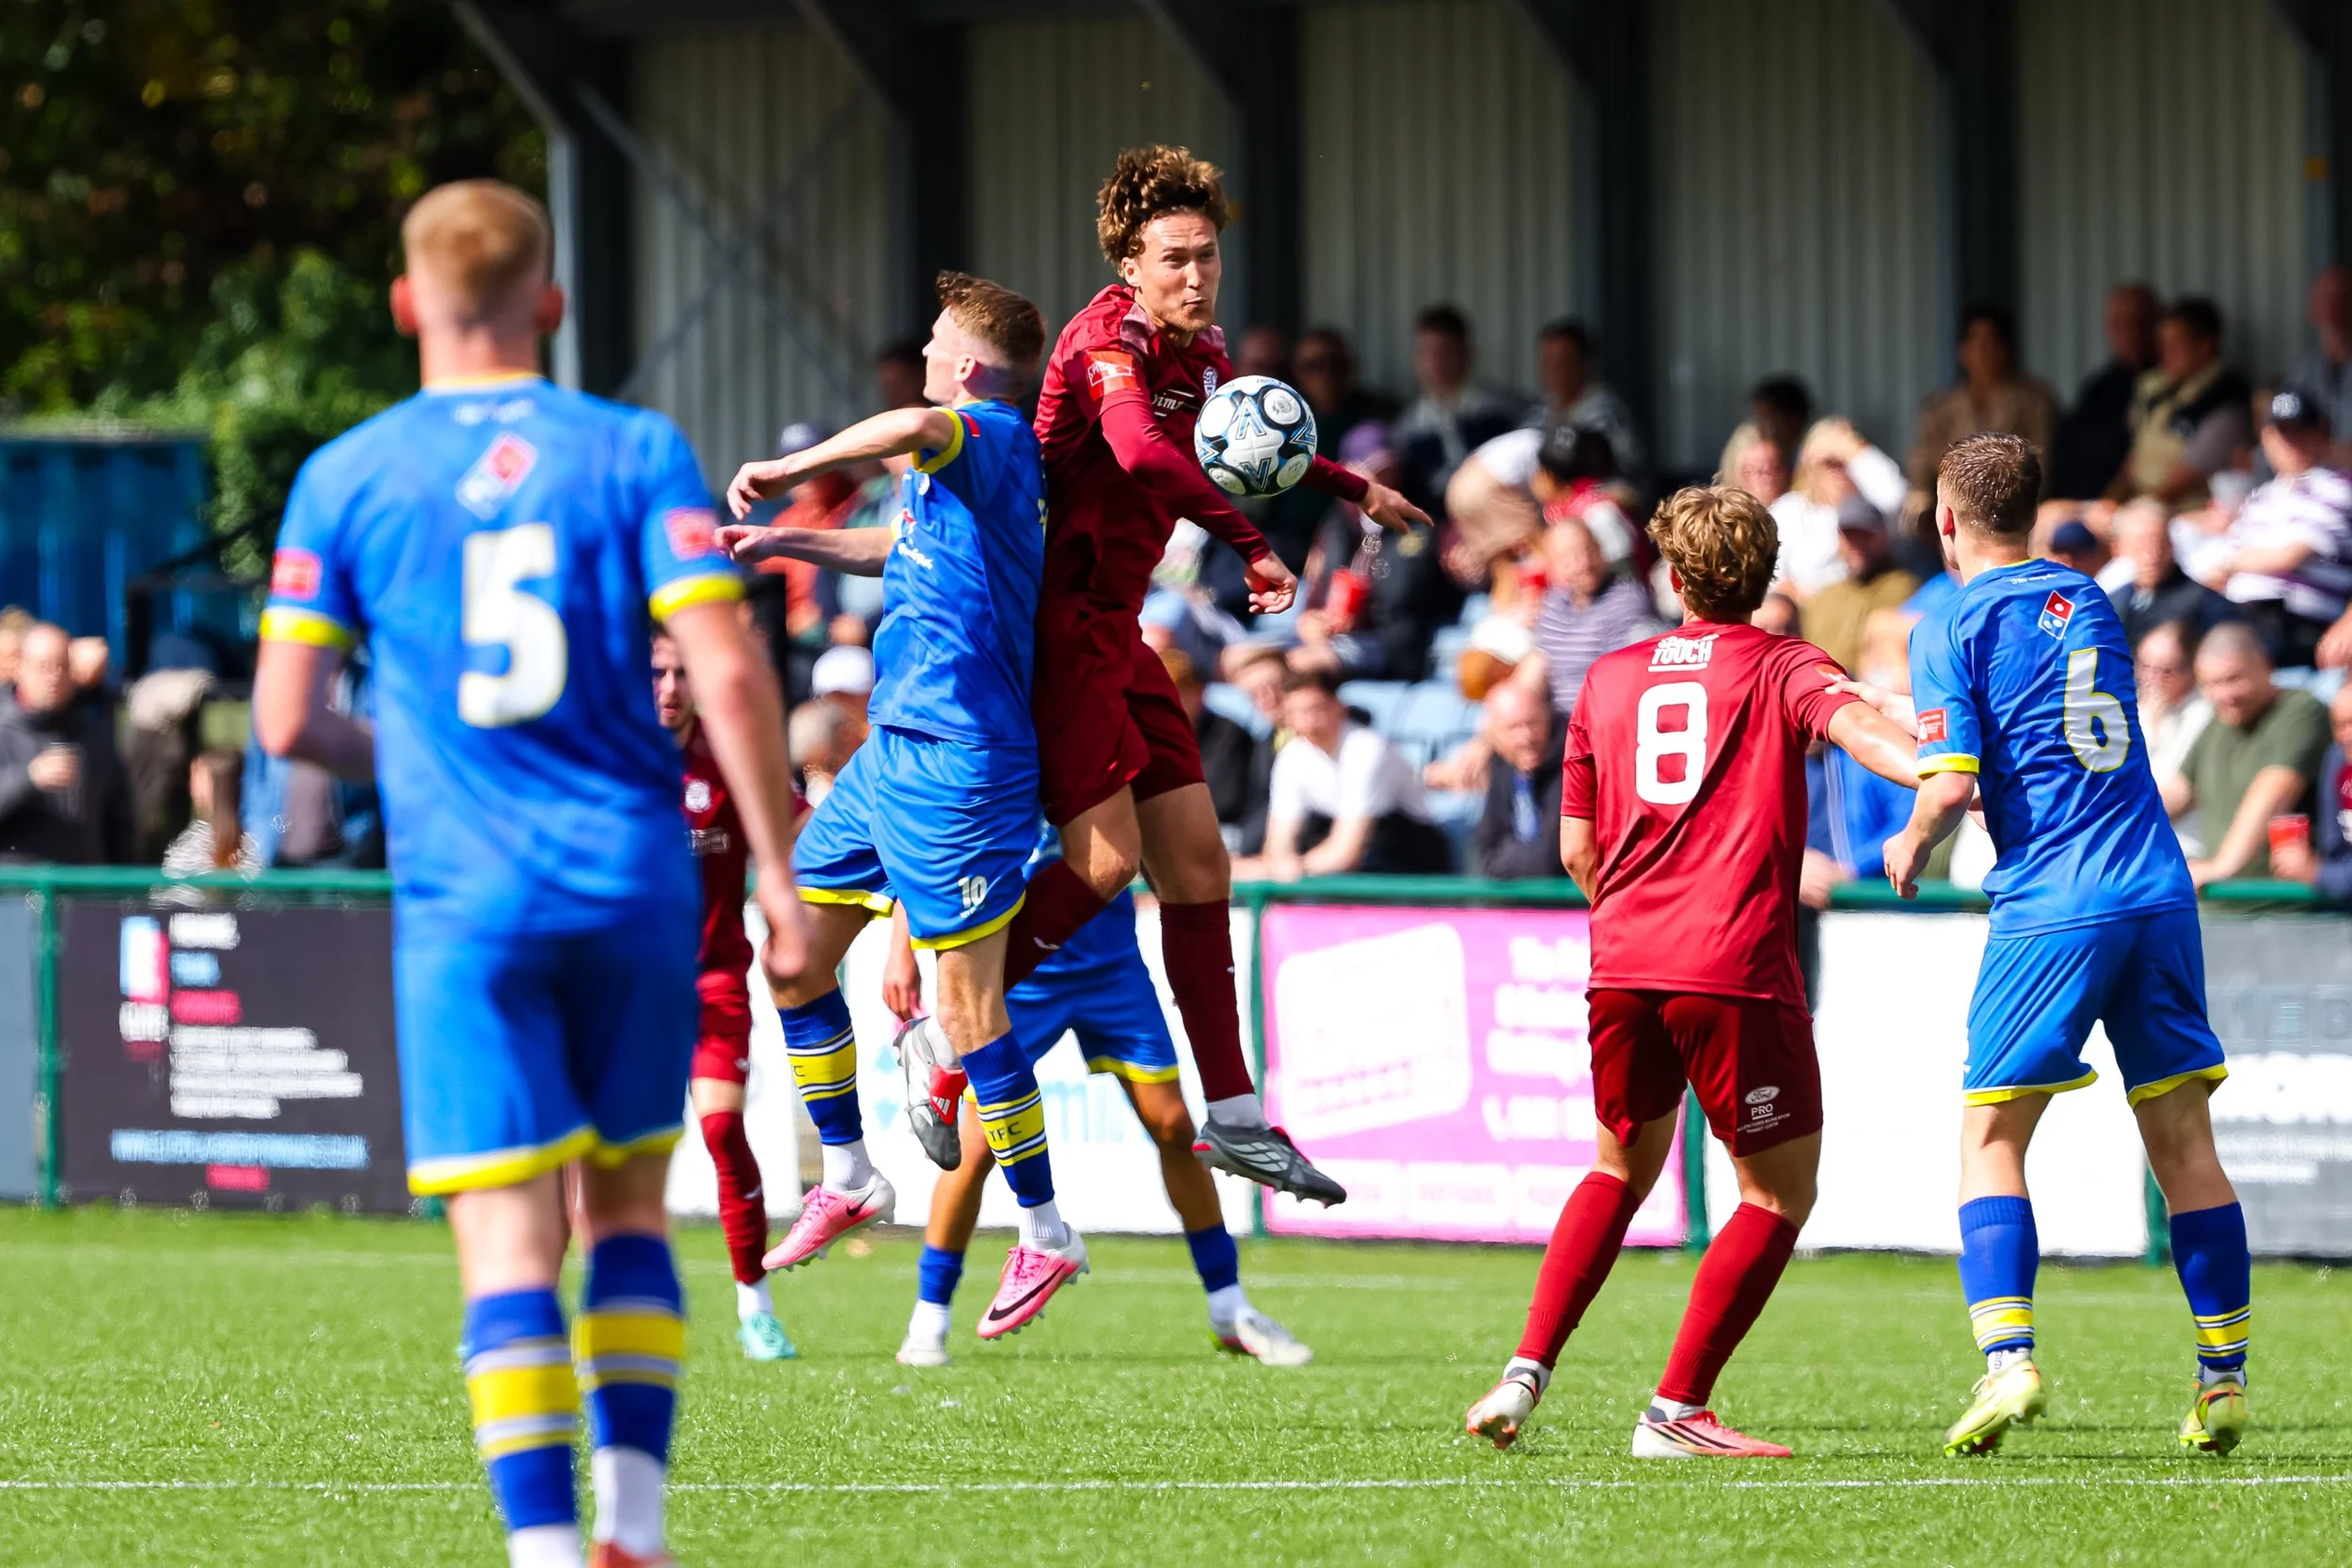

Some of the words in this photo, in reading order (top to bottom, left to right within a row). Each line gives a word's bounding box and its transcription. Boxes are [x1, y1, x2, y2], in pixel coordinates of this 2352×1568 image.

[459, 522, 567, 728] 5
[1635, 681, 1708, 805] 8
[2064, 647, 2131, 772] 6
[958, 875, 988, 910] 10
[989, 1120, 1023, 1142] TFC
[1751, 1103, 1773, 1117] PRO
